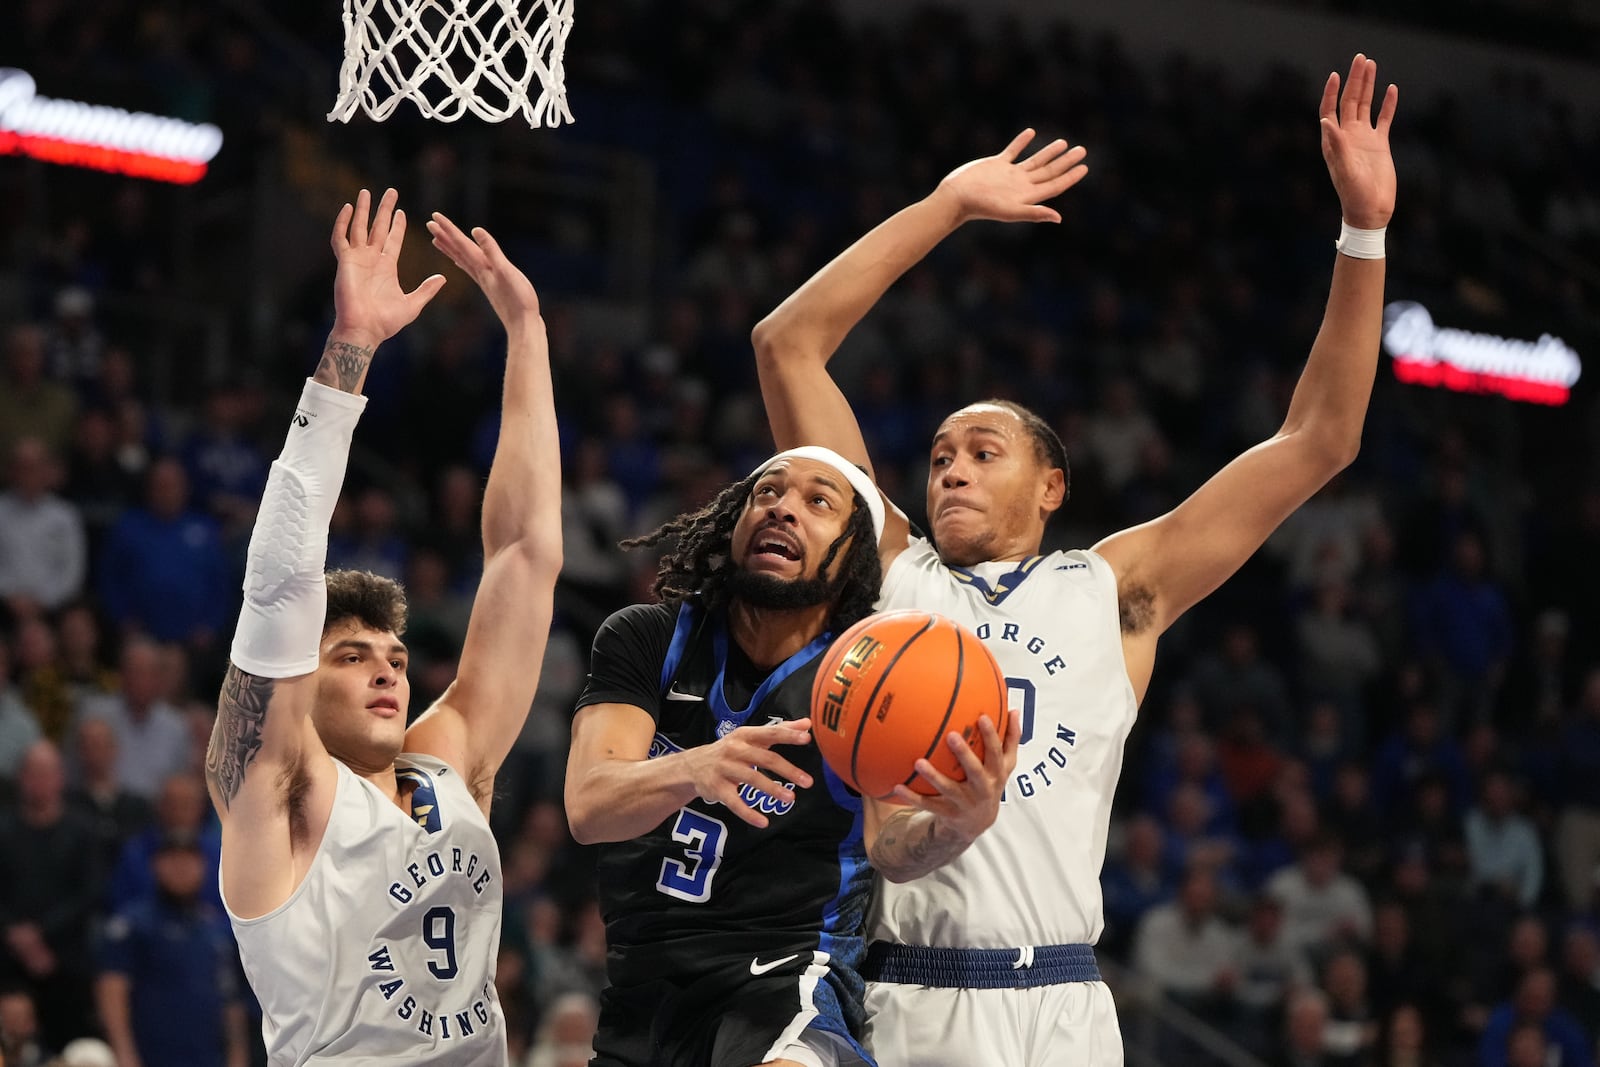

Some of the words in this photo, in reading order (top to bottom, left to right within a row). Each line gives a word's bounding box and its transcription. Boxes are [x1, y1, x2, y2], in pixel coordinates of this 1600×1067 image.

[976, 622, 1066, 676] ORGE
[1005, 676, 1036, 745] 0
[389, 848, 491, 904] GEORGE
[656, 807, 728, 903] 3
[423, 906, 459, 980] 9
[368, 945, 491, 1039] WASHING
